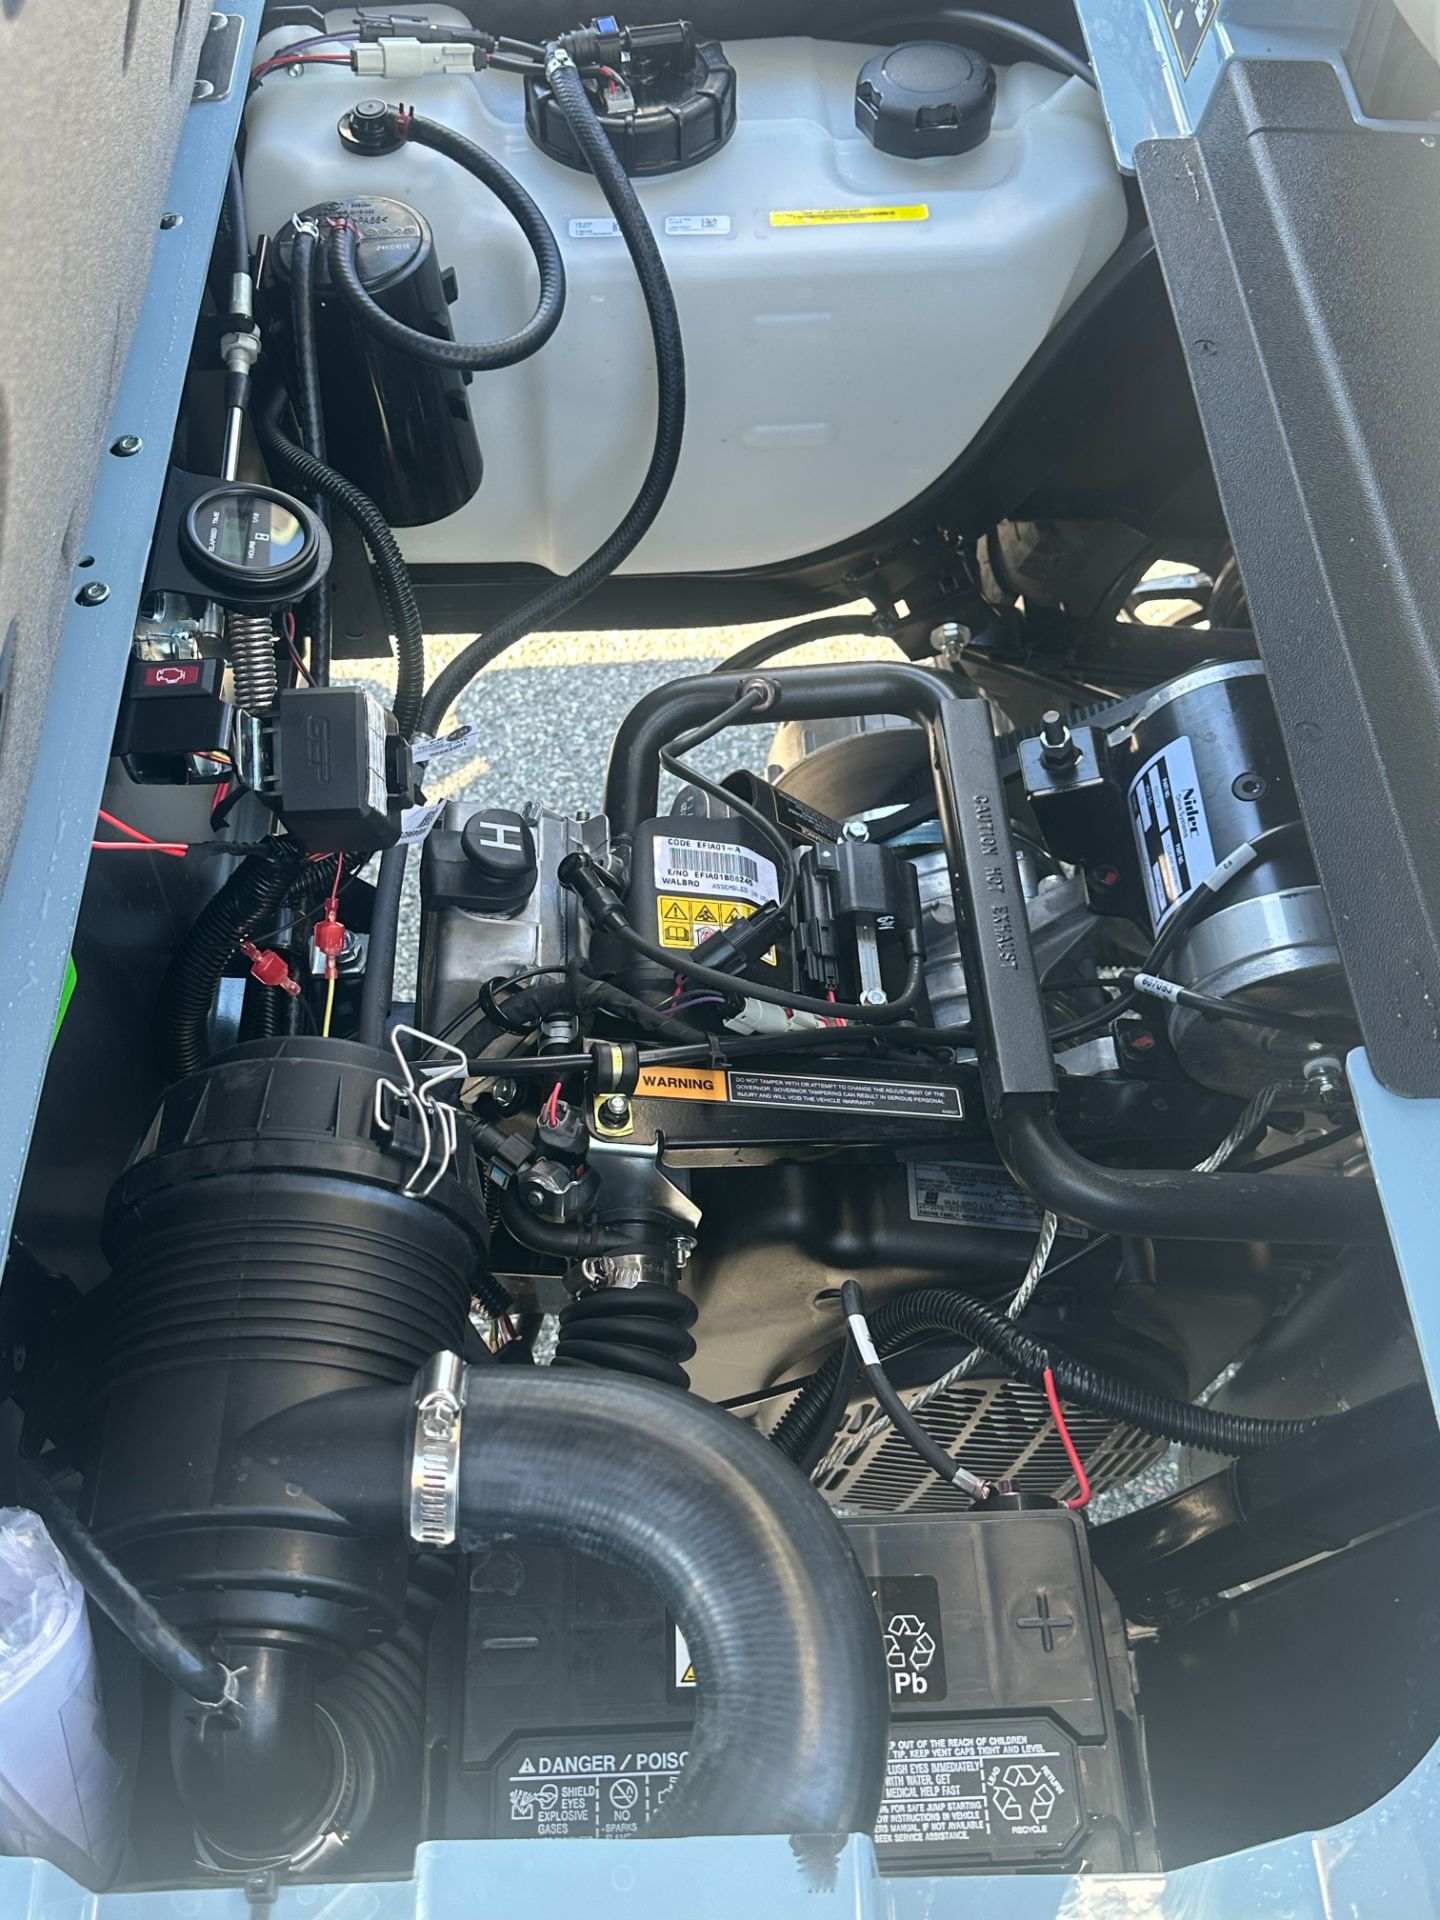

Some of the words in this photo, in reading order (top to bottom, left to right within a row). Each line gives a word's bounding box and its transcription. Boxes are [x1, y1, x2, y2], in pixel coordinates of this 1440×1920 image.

[212, 512, 220, 524] TIME
[248, 540, 256, 558] HOURS
[1182, 788, 1200, 838] Nidec
[973, 794, 998, 856] CAUTION
[480, 821, 522, 851] H
[668, 838, 690, 848] CODE
[668, 868, 688, 877] E/NO
[662, 877, 700, 887] WALBRO
[985, 866, 1005, 894] HOT
[992, 905, 1018, 972] EXHAUST
[643, 1076, 714, 1090] WARNING
[894, 1672, 928, 1694] Pb
[898, 1740, 914, 1749] OUT
[917, 1740, 928, 1749] OF
[930, 1739, 945, 1748] THE
[948, 1738, 974, 1747] REACH
[976, 1737, 987, 1745] OF
[989, 1736, 1028, 1745] CHILDREN
[892, 1750, 908, 1759] TIP.
[910, 1749, 930, 1758] KEEP
[931, 1748, 952, 1757] VENT
[954, 1747, 975, 1756] CAPS
[977, 1746, 1000, 1755] TIGHT
[1003, 1745, 1019, 1753] AND
[1021, 1744, 1046, 1753] LEVEL
[538, 1755, 616, 1774] DANGER
[636, 1751, 689, 1770] POIS
[887, 1764, 908, 1775] LUSH
[910, 1763, 929, 1774] EYES
[931, 1761, 980, 1773] IMMEDIATELY
[885, 1776, 904, 1787] WITH
[935, 1774, 951, 1785] GET
[986, 1766, 1000, 1786] LEAD
[1041, 1765, 1065, 1795] RETURN
[561, 1785, 596, 1797] SHIELD
[886, 1787, 918, 1798] MEDICAL
[920, 1786, 940, 1797] HELP
[942, 1785, 960, 1796] FAST
[561, 1798, 586, 1809] EYES
[890, 1804, 905, 1813] FOR
[907, 1803, 925, 1812] SAFE
[926, 1803, 946, 1812] JUMP
[947, 1801, 982, 1811] STARTING
[538, 1810, 588, 1823] EXPLOSIVE
[614, 1810, 630, 1821] NO
[890, 1813, 940, 1822] INSTRUCTIONS
[942, 1812, 950, 1820] IN
[951, 1811, 980, 1820] VEHICLE
[538, 1823, 568, 1834] GASES
[605, 1823, 637, 1832] SPARKS
[874, 1824, 889, 1833] ERS
[922, 1823, 930, 1831] IF
[931, 1822, 946, 1830] NOT
[948, 1820, 984, 1830] AVAILABLE
[1012, 1825, 1048, 1834] RECYCLE
[874, 1834, 893, 1843] SEEK
[894, 1833, 923, 1842] SERVICE
[925, 1831, 970, 1841] ASSISTANCE.
